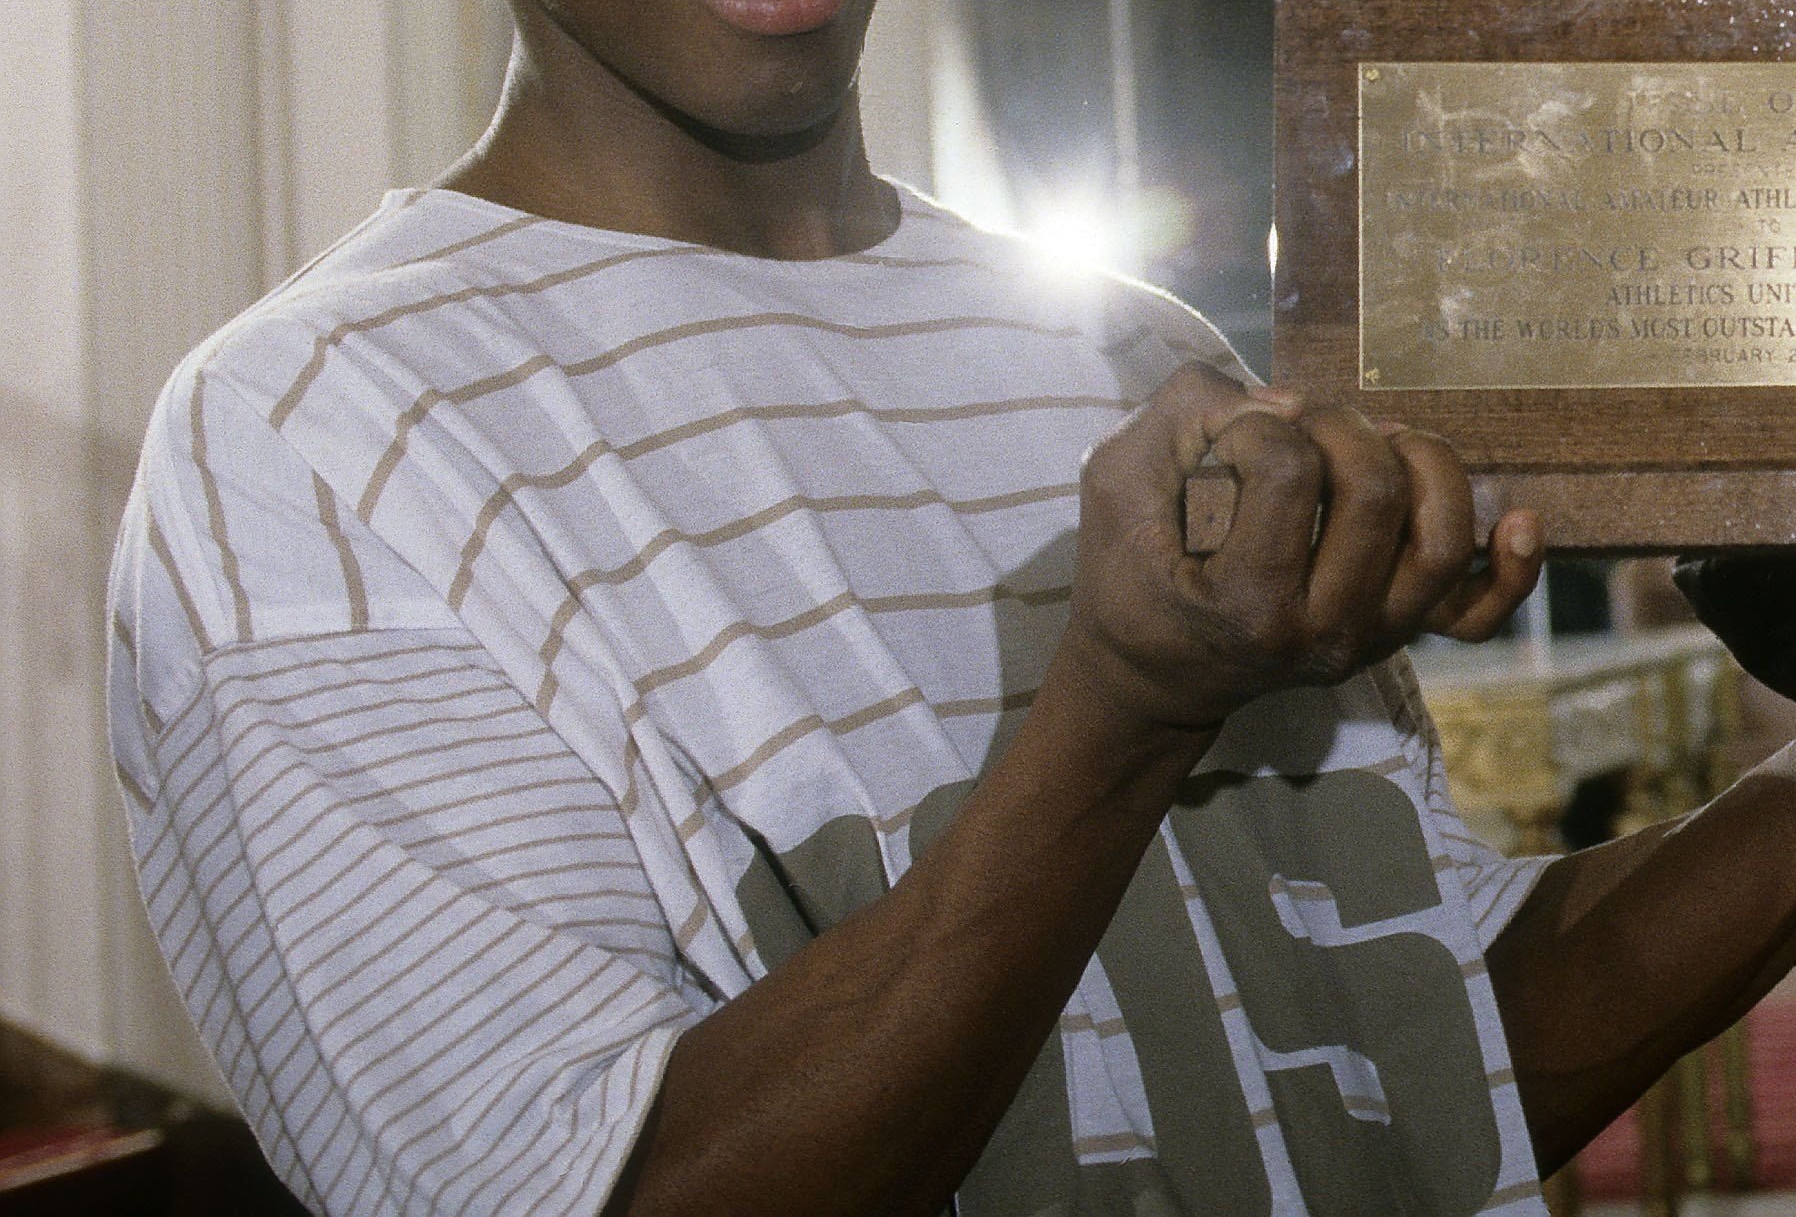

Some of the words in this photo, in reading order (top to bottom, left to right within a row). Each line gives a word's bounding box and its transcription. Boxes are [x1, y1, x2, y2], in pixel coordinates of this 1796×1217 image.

[1402, 129, 1758, 155] INTERNATIONAL
[1604, 187, 1719, 211] AMATEUR
[1756, 221, 1782, 235] TO
[1437, 246, 1659, 273] FLORENCE
[1605, 284, 1734, 307] ATHLETICS
[1460, 319, 1503, 341] THE
[1630, 317, 1693, 340] MOST
